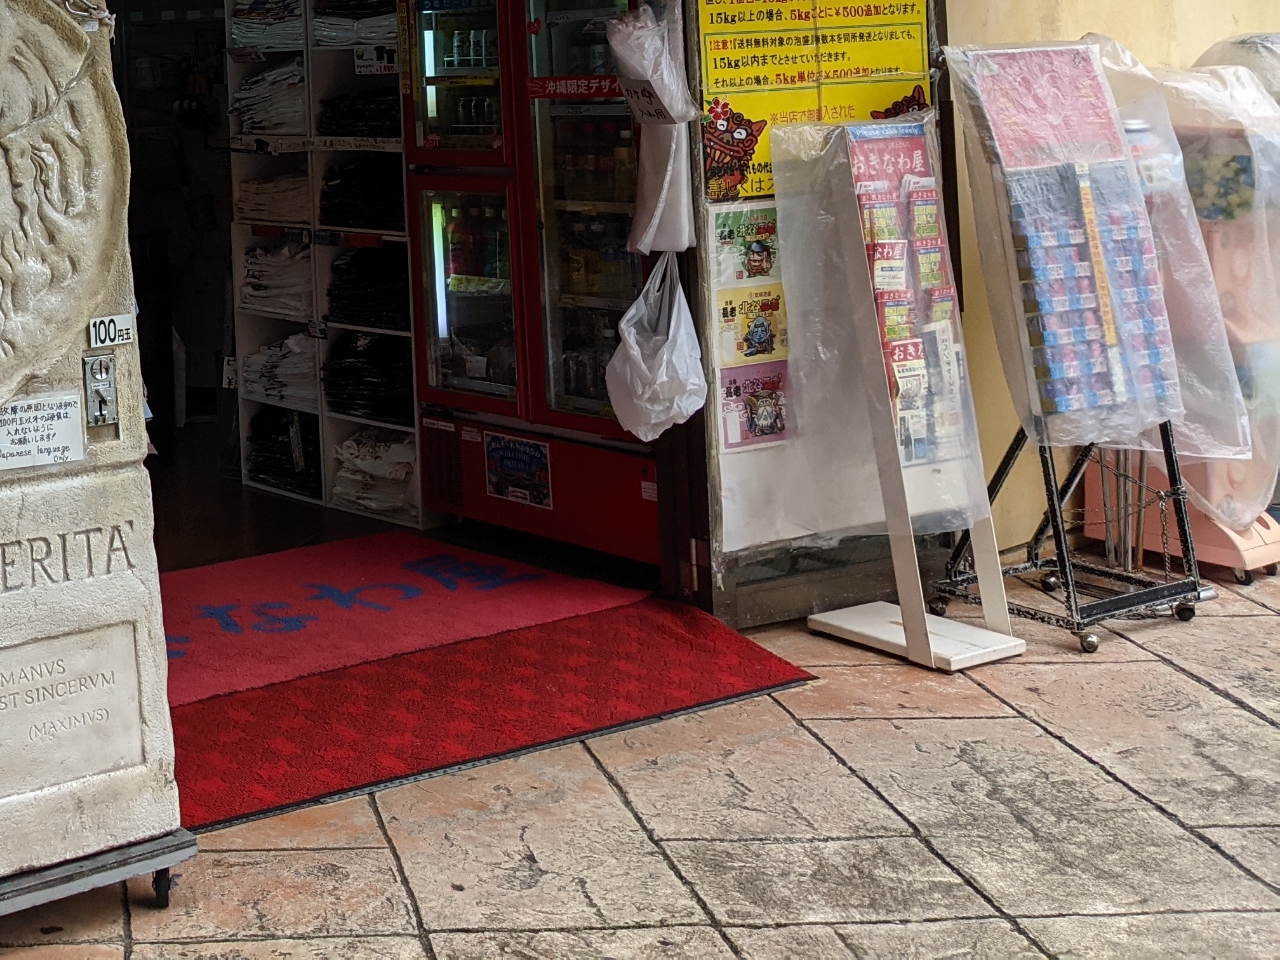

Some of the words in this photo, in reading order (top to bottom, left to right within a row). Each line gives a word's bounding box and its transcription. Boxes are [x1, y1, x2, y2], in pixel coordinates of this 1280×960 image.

[852, 150, 926, 176] おきなわ屋
[92, 318, 132, 345] 100円玉
[6, 423, 54, 437] 入れないように
[37, 444, 71, 456] language
[0, 658, 67, 689] MANVS
[24, 670, 116, 707] SINCERVM
[27, 707, 111, 744] (MAXIMVS)
